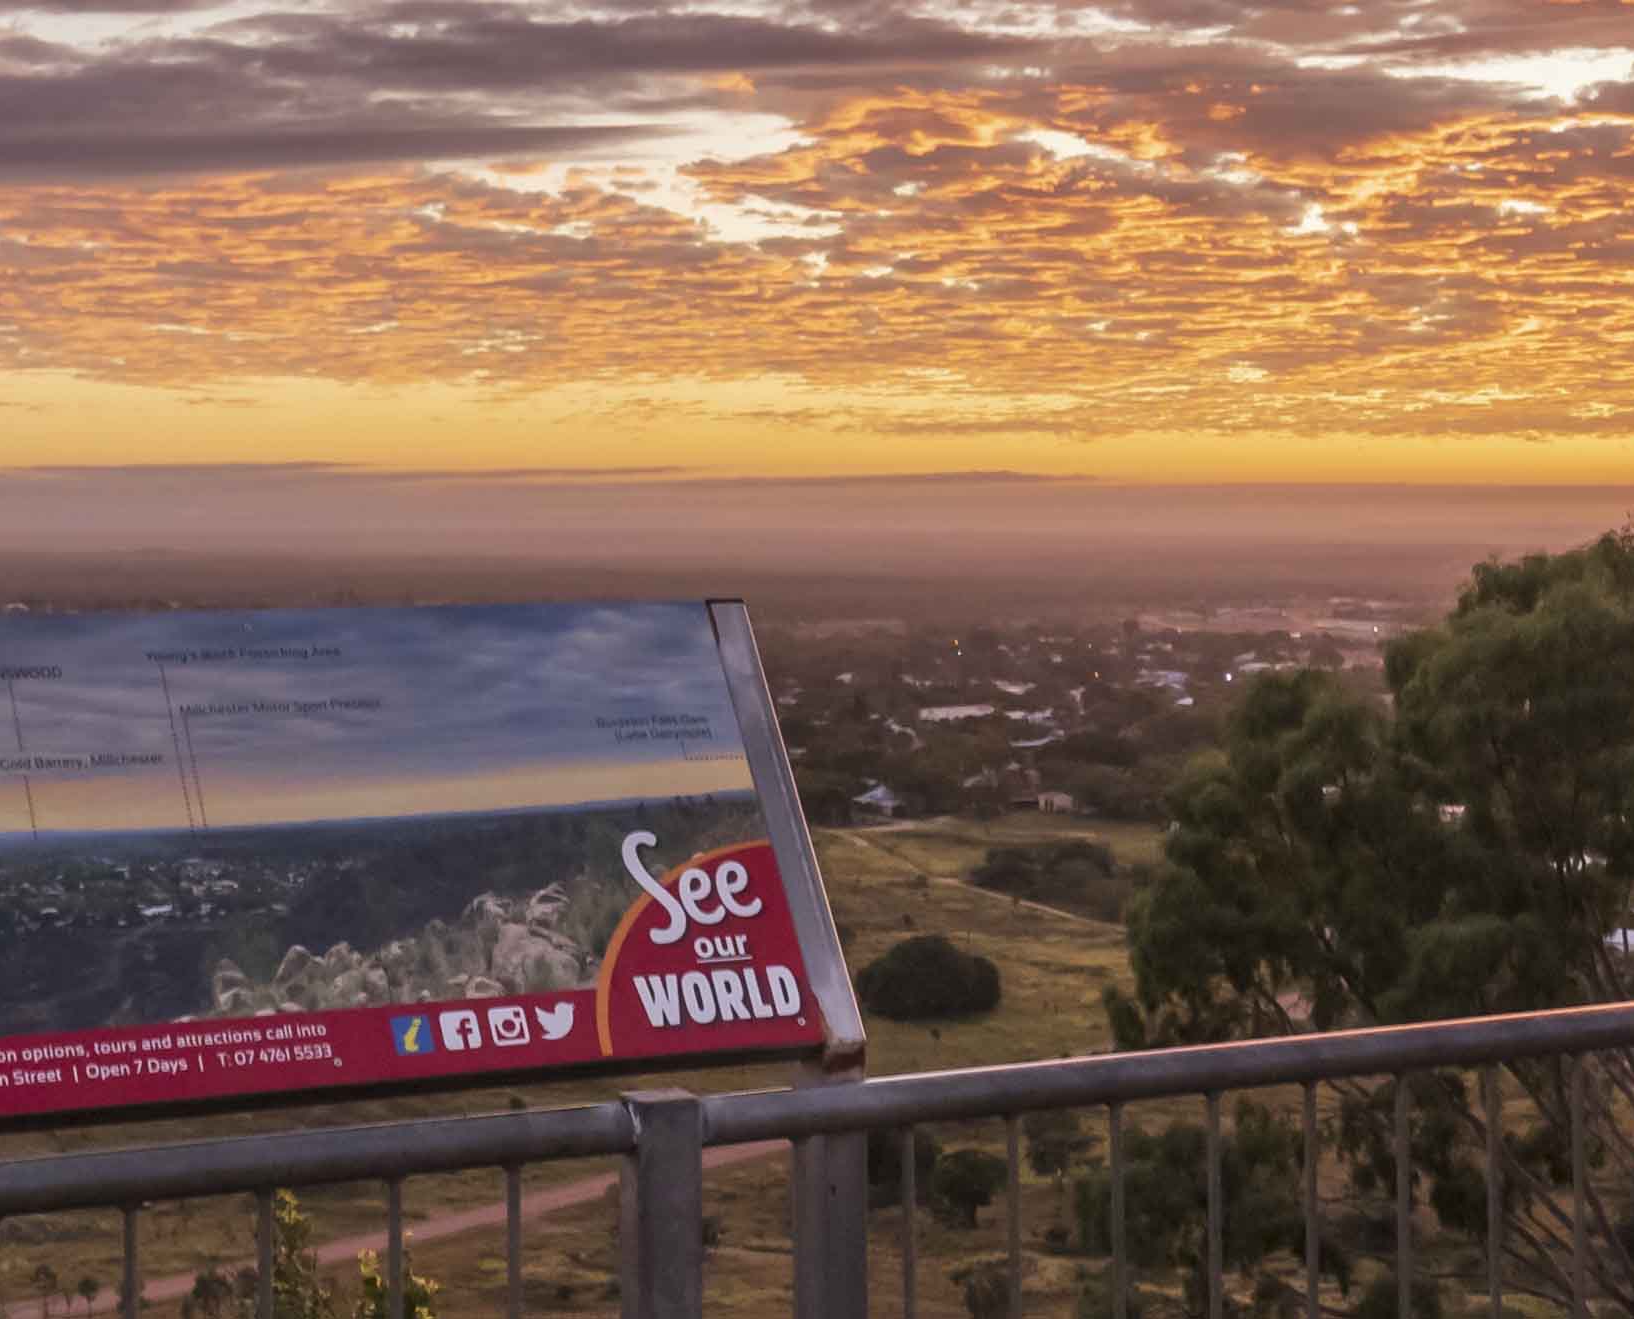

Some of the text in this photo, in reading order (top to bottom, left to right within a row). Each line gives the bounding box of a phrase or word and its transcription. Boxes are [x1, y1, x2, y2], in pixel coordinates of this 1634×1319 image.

[621, 829, 763, 945] See
[692, 933, 749, 960] our
[632, 964, 802, 1029] WORLD
[21, 1042, 91, 1064] options,
[93, 1037, 137, 1056] tours
[141, 1033, 173, 1052] and
[176, 1024, 262, 1048] attractions
[265, 1022, 294, 1042] call
[297, 1020, 328, 1038] into
[13, 1066, 64, 1086] Street
[85, 1059, 131, 1081] Open
[134, 1059, 144, 1075] 7
[147, 1054, 189, 1076] Days
[234, 1049, 255, 1066] 07
[259, 1045, 292, 1063] 4761
[294, 1043, 334, 1061] 5533
